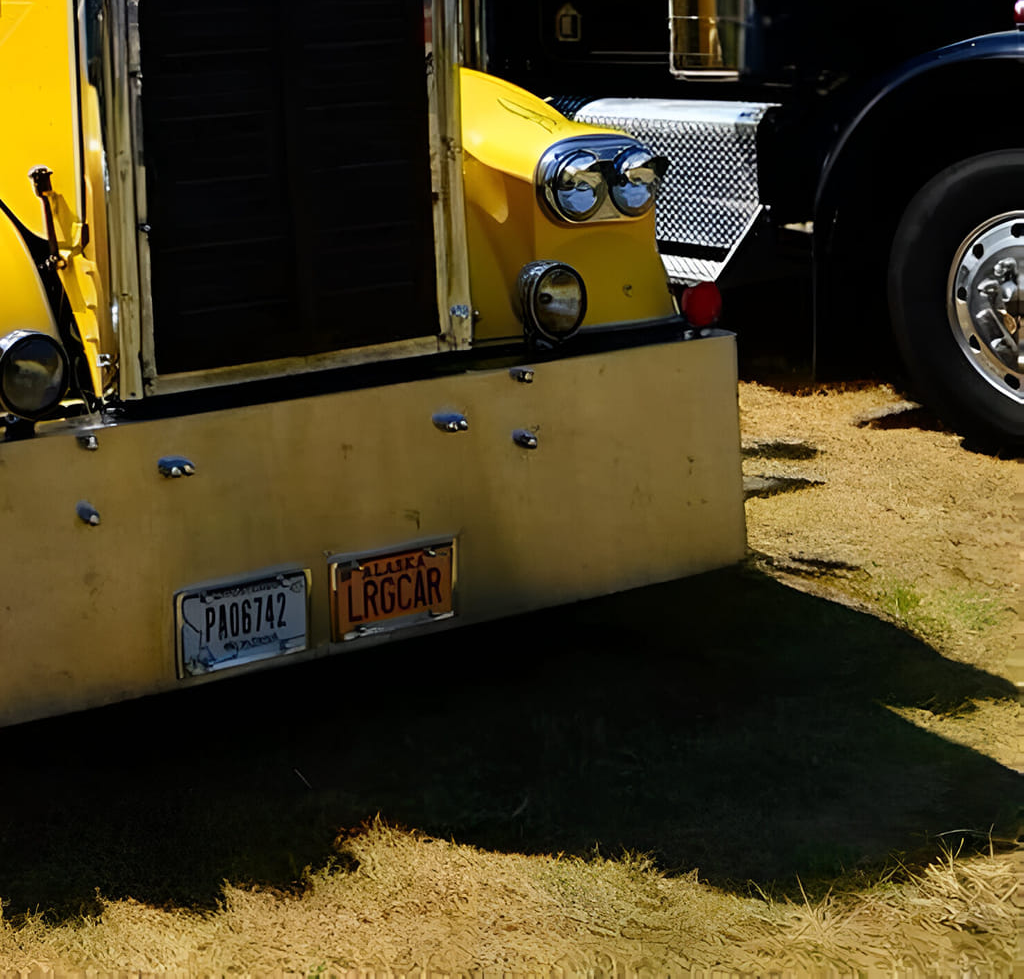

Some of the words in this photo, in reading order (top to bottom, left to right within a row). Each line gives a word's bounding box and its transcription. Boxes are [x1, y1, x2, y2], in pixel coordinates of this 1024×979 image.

[363, 554, 426, 579] ALASKA
[205, 592, 287, 642] PA06742
[348, 567, 442, 622] LRGCAR
